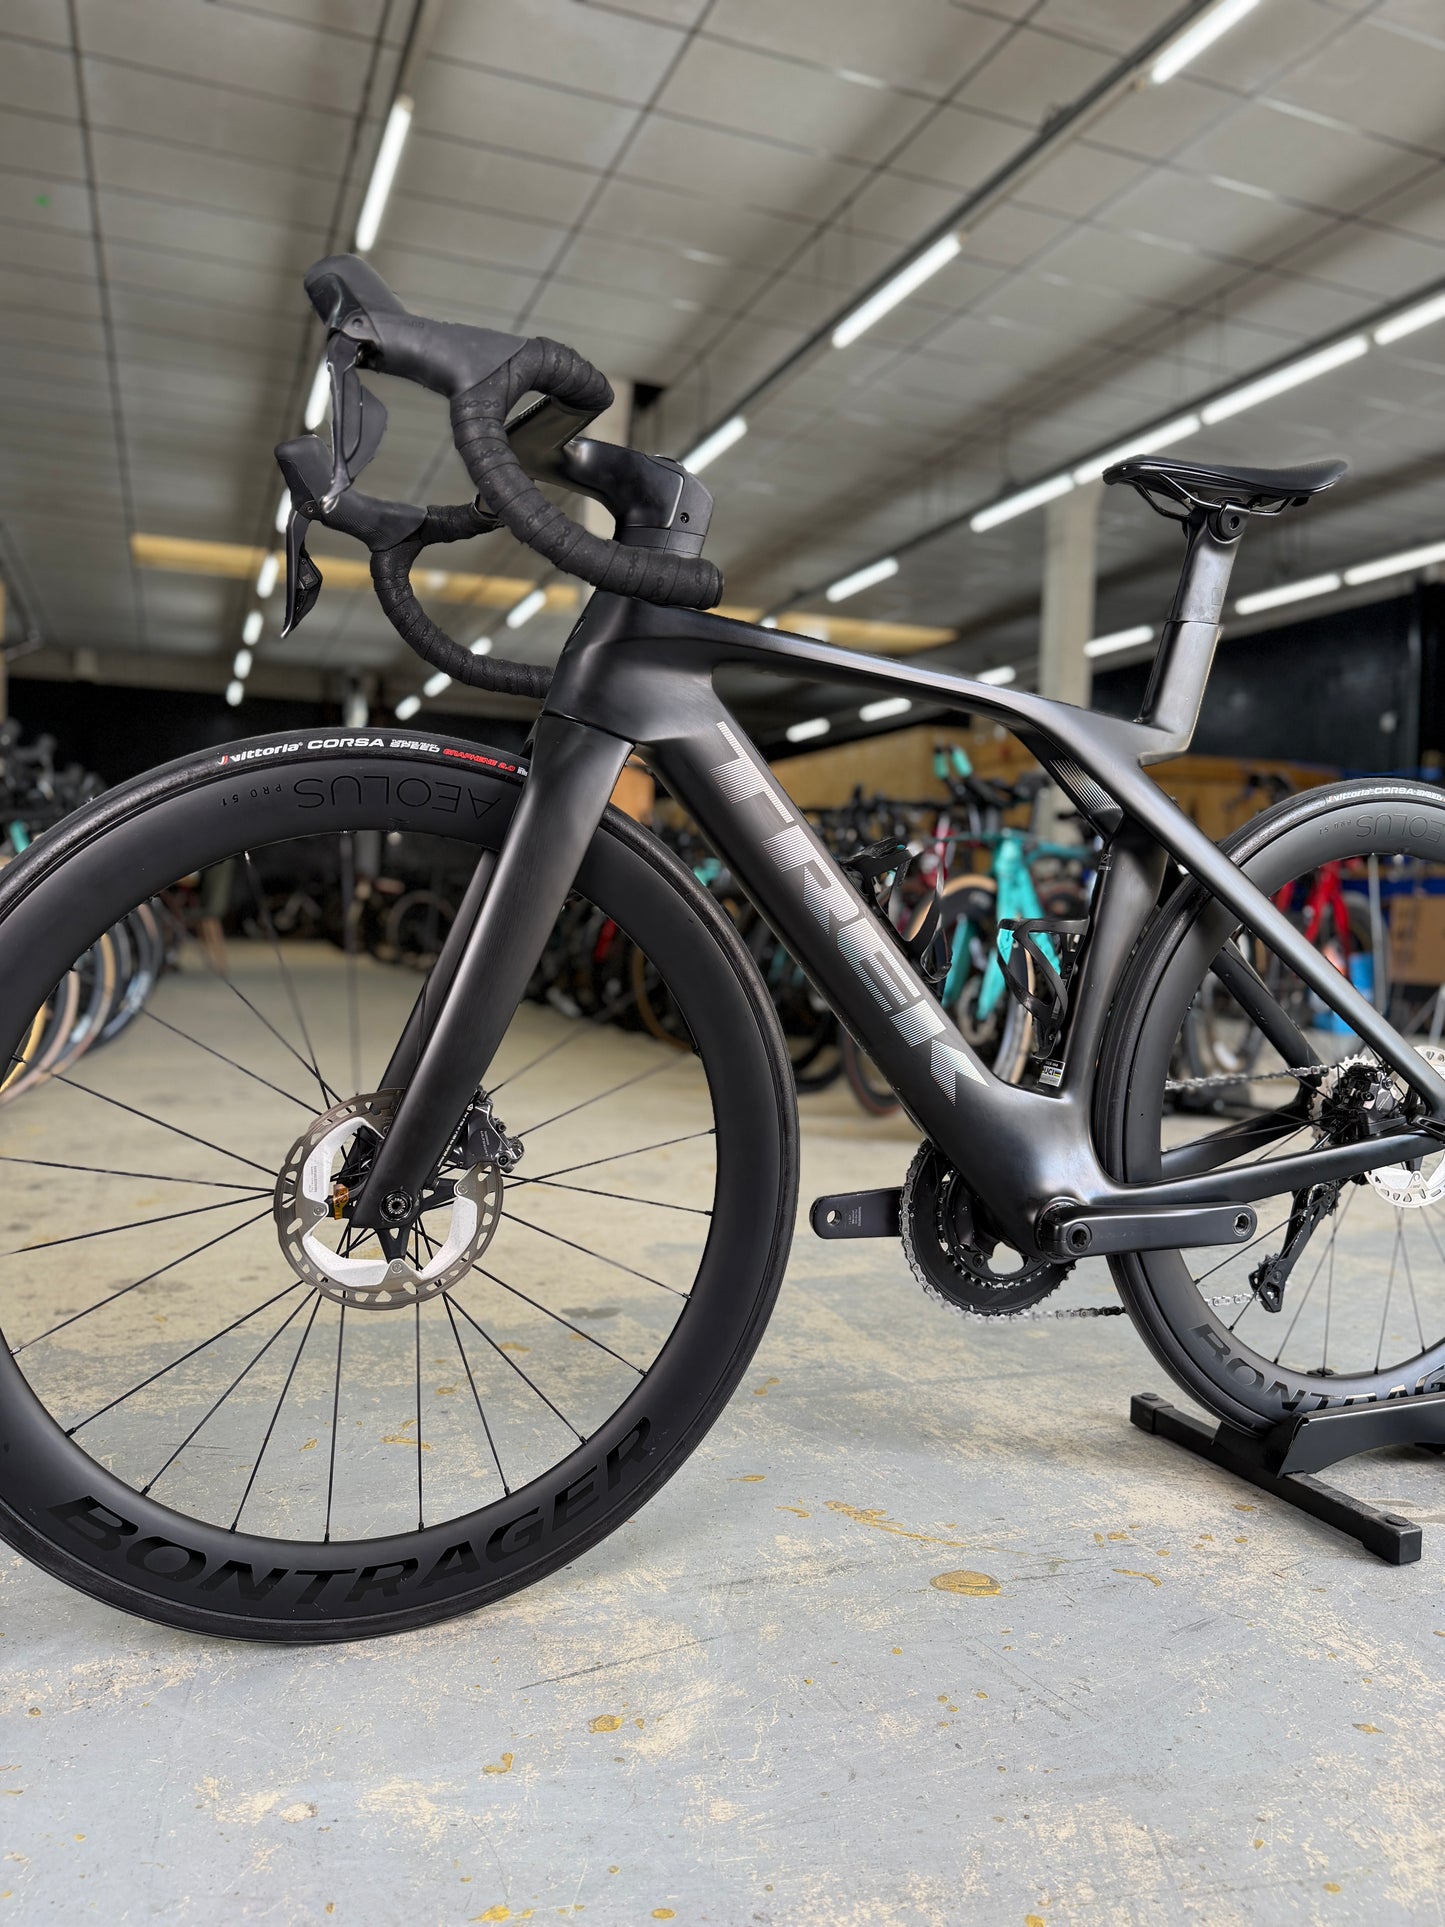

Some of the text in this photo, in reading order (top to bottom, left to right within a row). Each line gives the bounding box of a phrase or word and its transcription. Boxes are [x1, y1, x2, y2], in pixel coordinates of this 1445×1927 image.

[307, 738, 385, 750] CORSA
[221, 775, 501, 819] AEOLUS PRO 51
[1374, 787, 1415, 795] CORSA
[710, 721, 990, 1106] TREK
[48, 1417, 656, 1607] BONTRAGER
